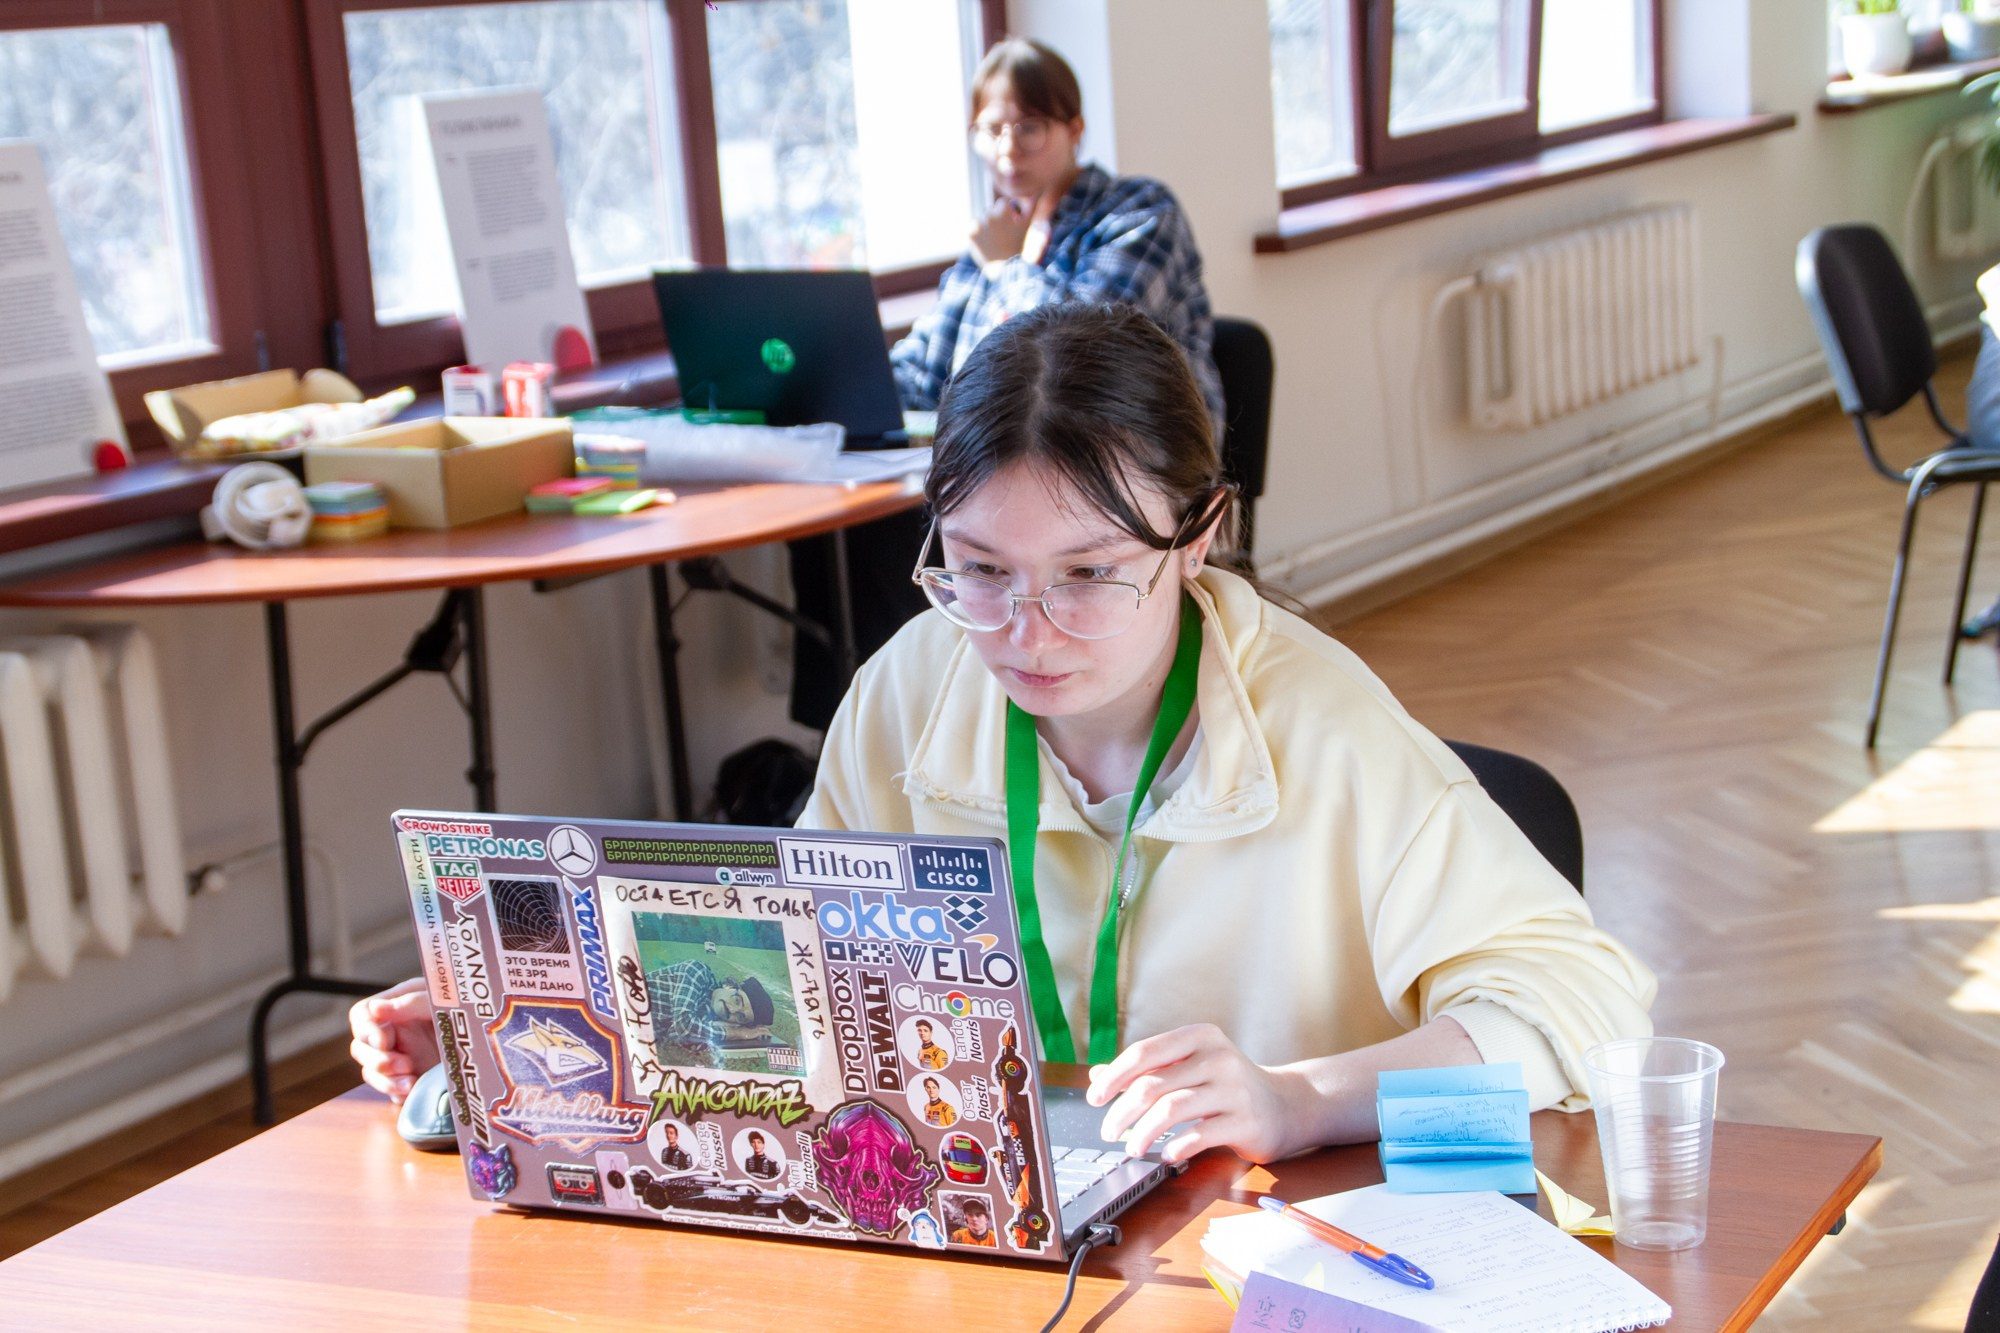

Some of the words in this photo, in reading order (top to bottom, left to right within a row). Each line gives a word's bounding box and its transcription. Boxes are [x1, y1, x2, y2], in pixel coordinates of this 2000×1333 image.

[403, 820, 491, 835] CROWDSTRIKE
[428, 836, 545, 858] PETRONAS
[410, 838, 427, 880] РАСТИ
[435, 862, 476, 876] TAG
[735, 871, 774, 885] allwyn
[790, 848, 894, 880] Hilton
[421, 884, 436, 929] ЧТОБЫ
[437, 878, 480, 899] HEUER
[818, 892, 953, 943] okta
[447, 923, 470, 1001] MARRIOTT
[457, 910, 494, 1017] BONVOY
[505, 956, 527, 966] ЭТО
[531, 957, 570, 968] ВРЕМЯ
[572, 886, 616, 1018] PRIMAX
[896, 942, 1018, 988] VELO
[507, 968, 525, 977] НЕ
[526, 969, 548, 979] ЗРЯ
[510, 979, 536, 989] НАМ
[540, 980, 574, 991] ДАНО
[894, 984, 1014, 1019] Chrome
[831, 968, 867, 1093] Dropbox
[953, 1019, 967, 1060] Lando
[966, 1020, 983, 1060] Norris
[963, 1081, 976, 1119] Oscar
[973, 1076, 991, 1120] Piastri
[697, 1123, 712, 1168] George
[708, 1123, 725, 1169] Russell
[797, 1133, 816, 1191] Antonelli
